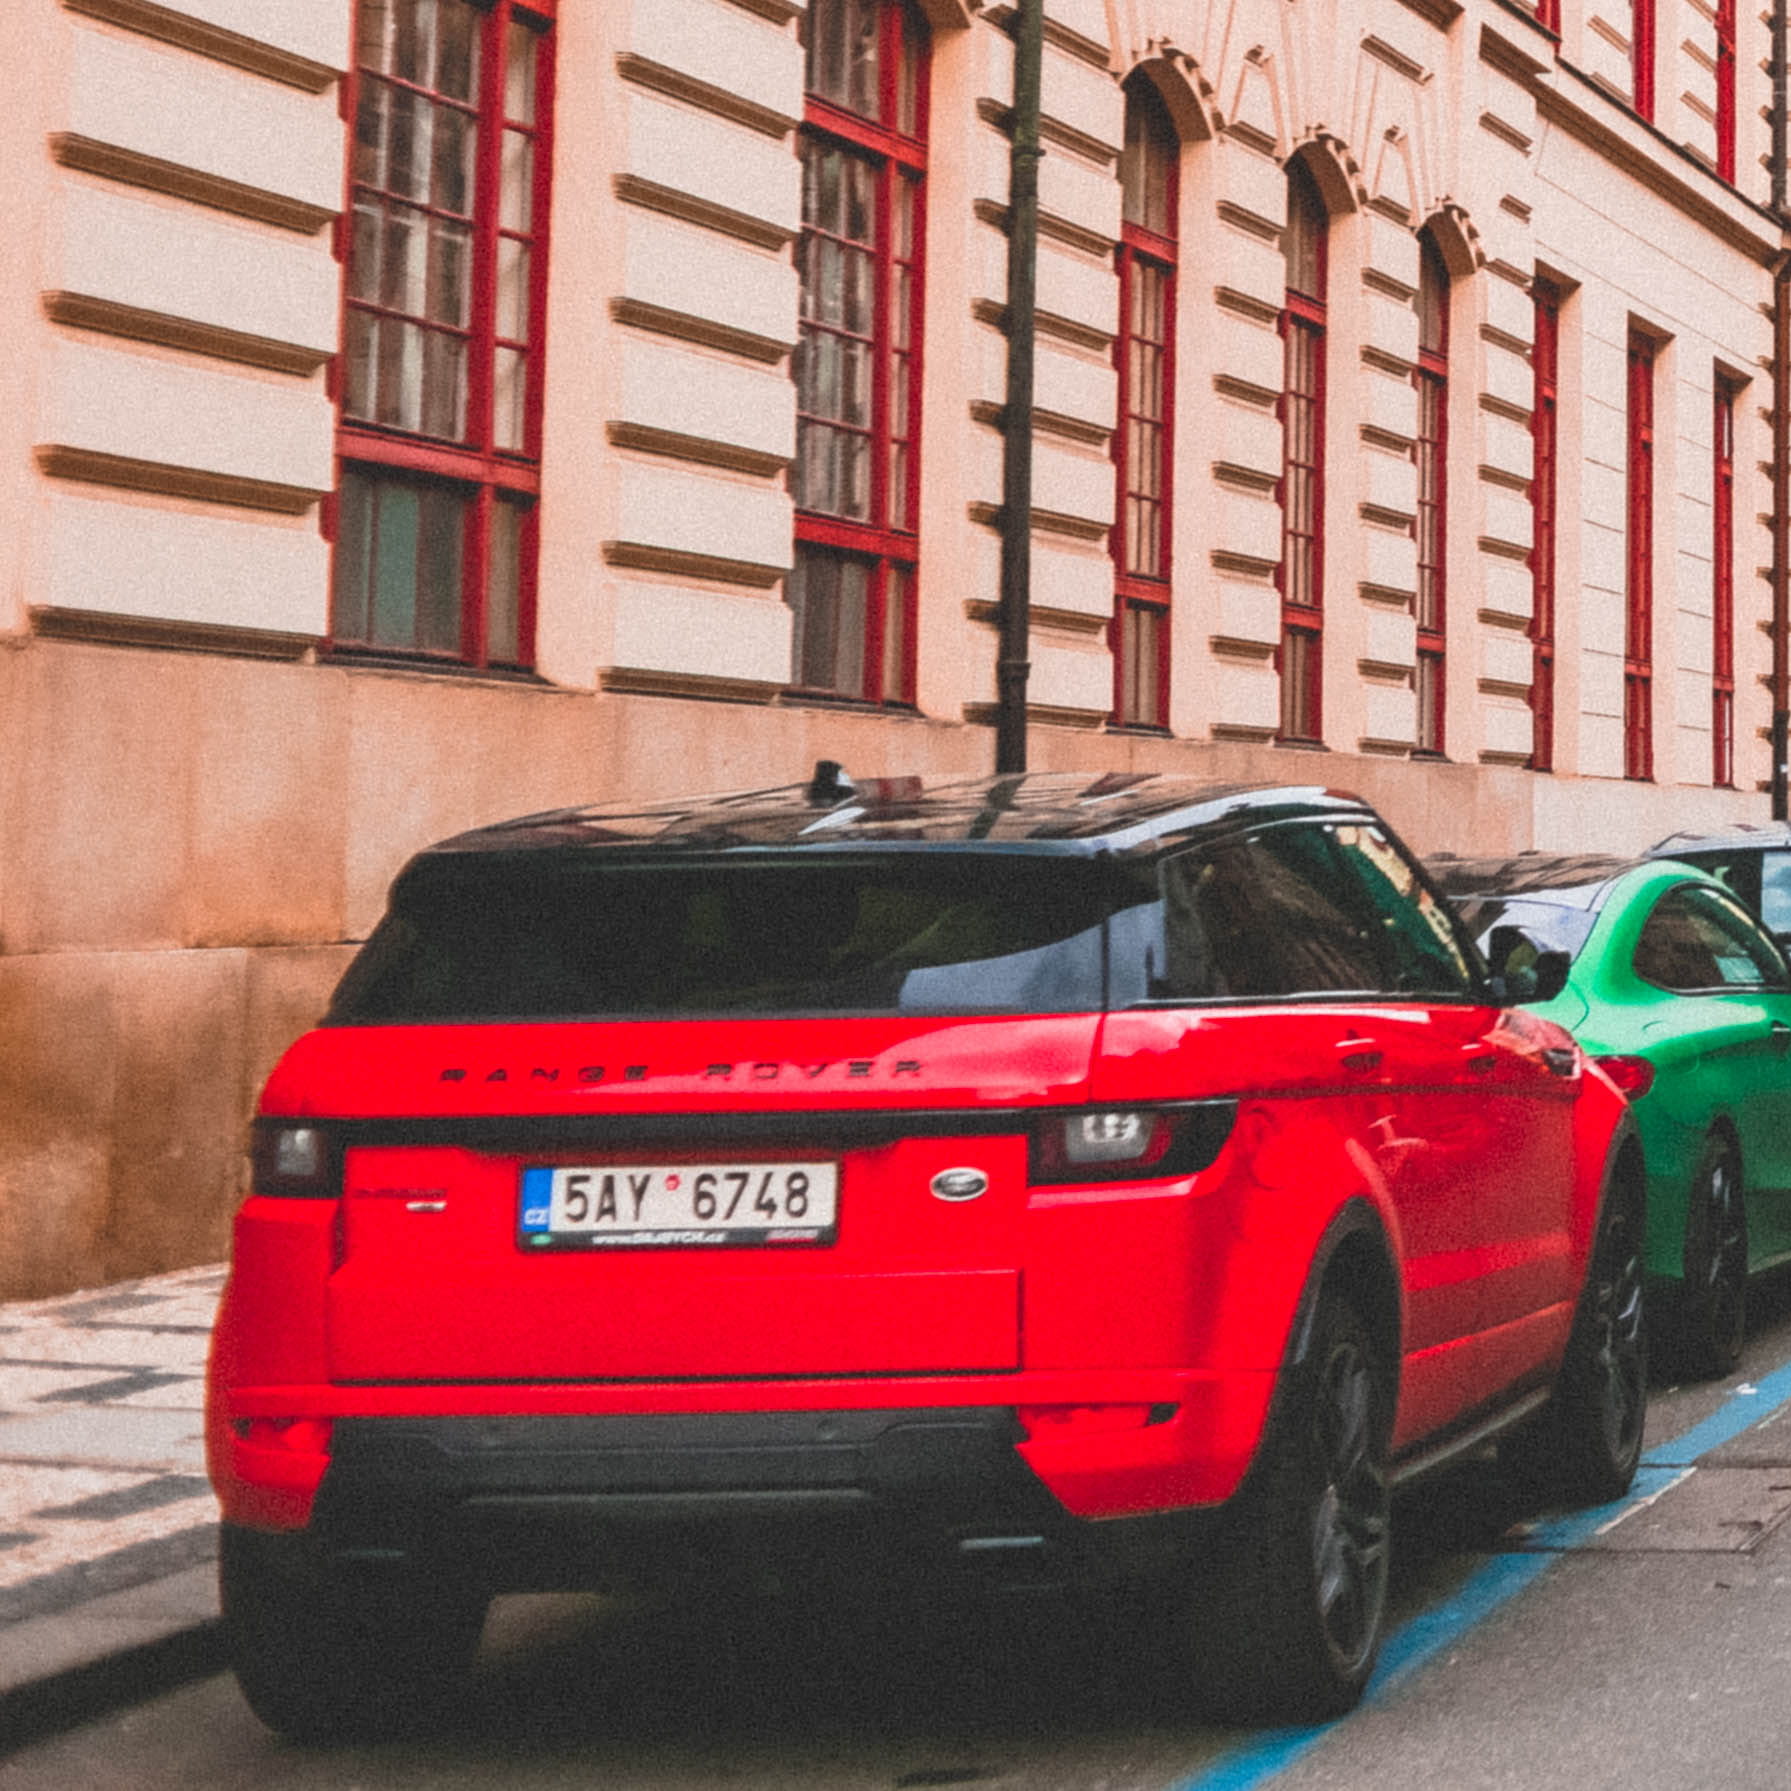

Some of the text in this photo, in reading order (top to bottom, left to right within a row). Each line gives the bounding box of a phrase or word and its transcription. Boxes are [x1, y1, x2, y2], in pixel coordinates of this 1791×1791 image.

[440, 1061, 921, 1082] RANGE ROVER
[524, 1172, 810, 1225] CZ 5AY 6748
